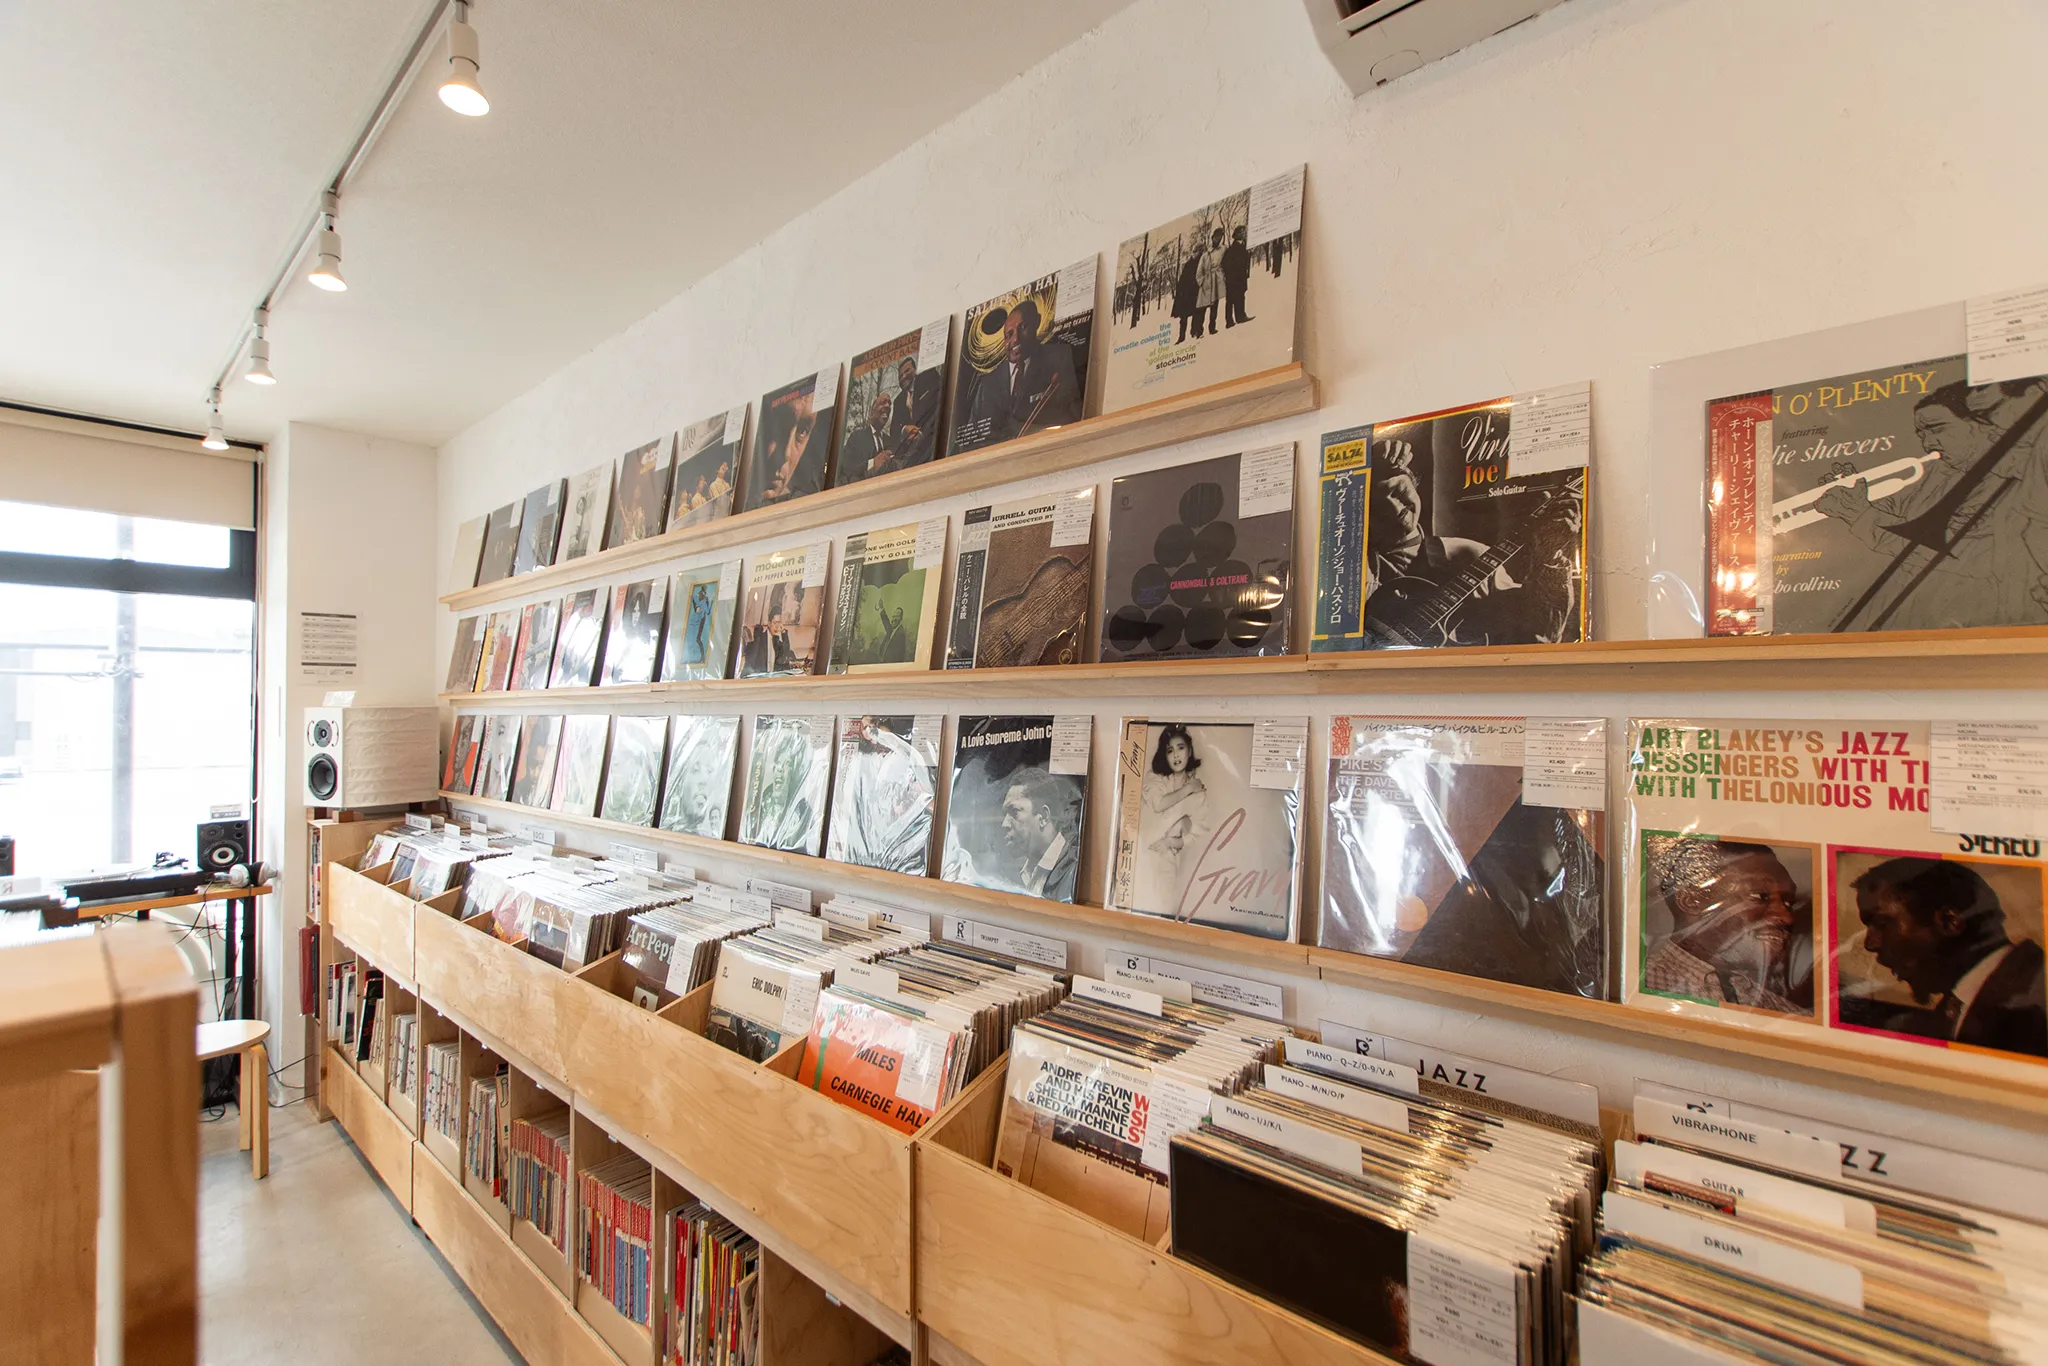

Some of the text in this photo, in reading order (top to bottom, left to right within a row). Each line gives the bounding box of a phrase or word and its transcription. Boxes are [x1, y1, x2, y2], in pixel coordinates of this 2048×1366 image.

[1014, 283, 1031, 301] TO
[1140, 330, 1171, 345] coleman
[1159, 323, 1171, 331] the
[1155, 352, 1196, 370] stockholm
[1817, 371, 1936, 408] PLENTY
[1781, 425, 1829, 441] featuring
[1800, 434, 1896, 465] shavers
[1464, 464, 1498, 489] Joe
[1488, 485, 1526, 498] Solo Guitar
[1007, 516, 1043, 527] CONDUCTED
[879, 541, 895, 551] with
[1773, 549, 1822, 562] narration
[755, 556, 795, 573] modern
[1777, 565, 1790, 576] by
[753, 574, 764, 583] ART
[764, 570, 785, 582] PEPPER
[1170, 574, 1249, 590] CANNONBALL & COLTRANE
[1794, 578, 1842, 592] collins
[961, 735, 967, 748] A
[967, 733, 984, 748] Love
[985, 729, 1021, 744] Supreme
[1023, 727, 1044, 741] John
[1640, 727, 1910, 756] ART BLAKEY'S JAZZ
[1340, 759, 1382, 771] PIKE'S
[1631, 750, 1799, 779] MESSENGERS
[1812, 757, 1887, 783] WITH
[1339, 776, 1397, 788] THE DAVE
[1635, 774, 1696, 798] WITH
[1706, 778, 1872, 809] THELONIOUS
[1118, 840, 1134, 903] 阿川泰子
[626, 924, 648, 949] Art
[751, 977, 783, 999] ERIC DOLPHY
[1091, 985, 1106, 995] PIANO
[857, 1045, 896, 1072] MILES
[1306, 1049, 1332, 1062] PIANO
[1040, 1061, 1082, 1084] ANDRÉ
[1084, 1076, 1132, 1102] PREVIN
[1416, 1058, 1488, 1093] JAZZ
[831, 1076, 893, 1114] CARNEGIE
[1045, 1075, 1072, 1092] AND
[1074, 1085, 1095, 1101] HIS
[1097, 1093, 1130, 1115] PALS
[1280, 1074, 1304, 1088] PIANO
[1311, 1085, 1345, 1100] M/N/O/P
[1035, 1082, 1077, 1106] SHELLY
[1081, 1100, 1129, 1127] MANNE
[1226, 1106, 1249, 1120] PIANO
[1027, 1091, 1035, 1103] &
[1037, 1095, 1060, 1113] RED
[1062, 1105, 1126, 1140] MITCHELL
[1671, 1114, 1757, 1145] VIBRAPHONE
[1701, 1177, 1745, 1198] GUITAR
[1704, 1235, 1743, 1258] DRUM
